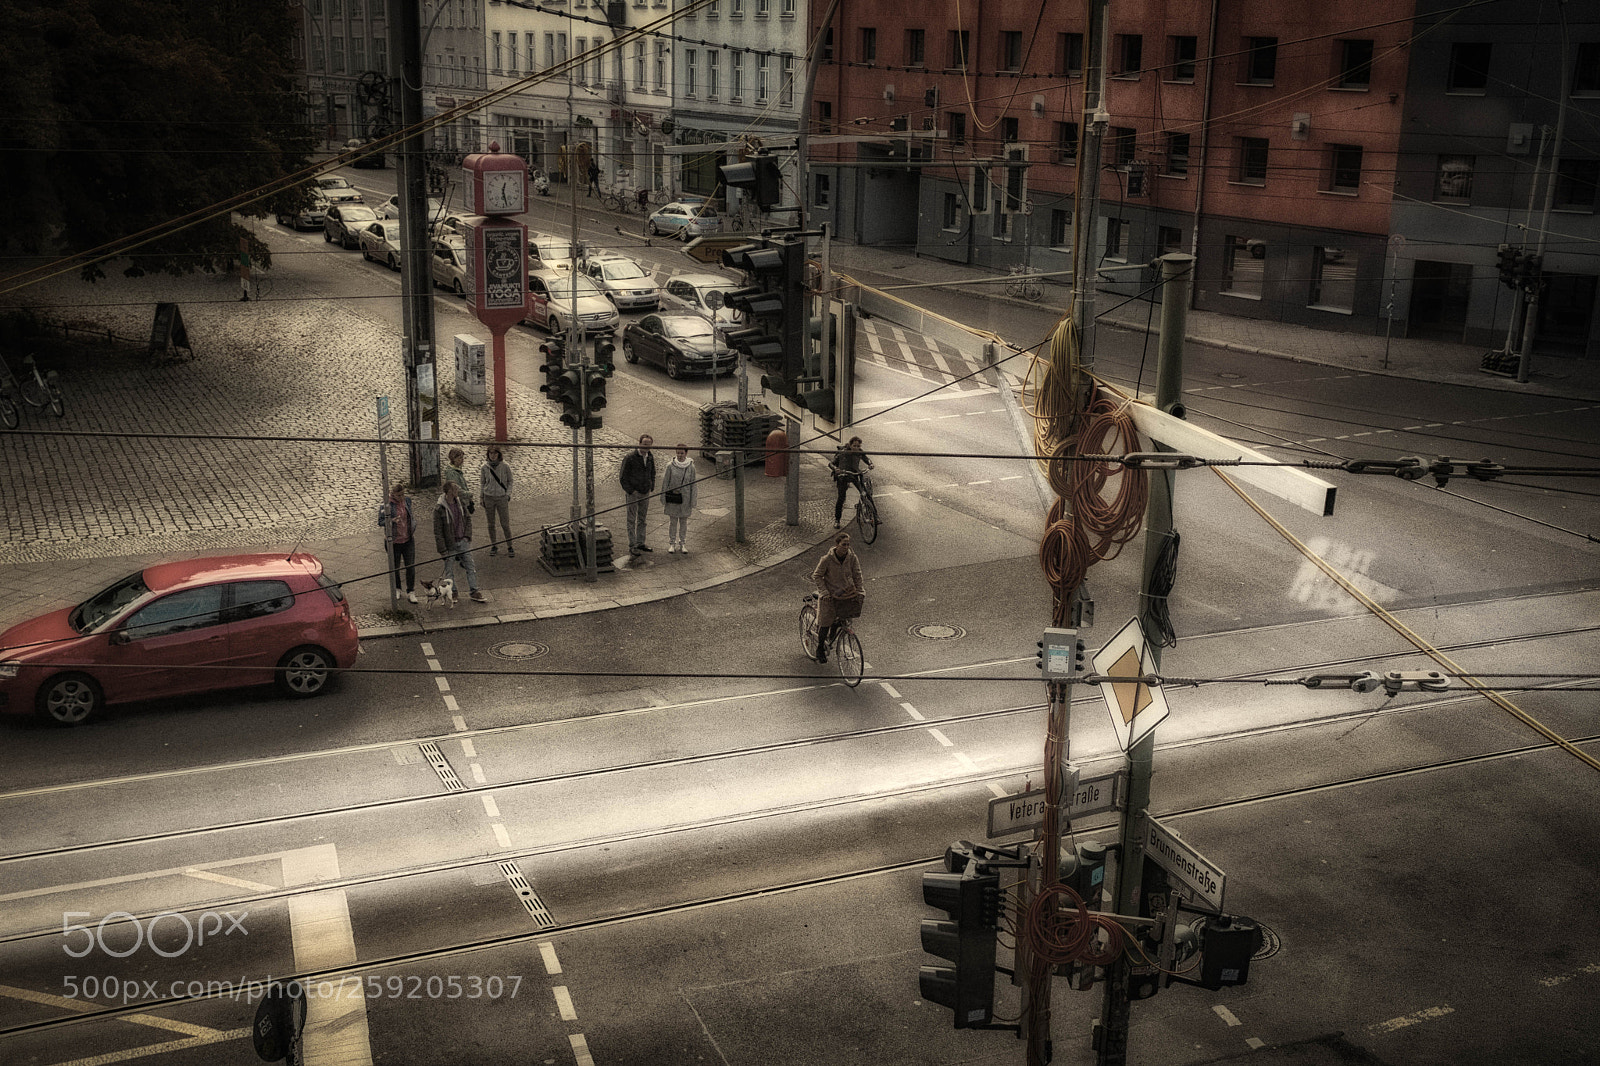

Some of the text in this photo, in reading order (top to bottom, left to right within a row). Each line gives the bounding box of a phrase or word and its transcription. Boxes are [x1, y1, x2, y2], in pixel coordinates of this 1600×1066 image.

[705, 247, 722, 256] Pre
[488, 289, 520, 298] YOGA
[1150, 828, 1217, 895] Brunnenstraße
